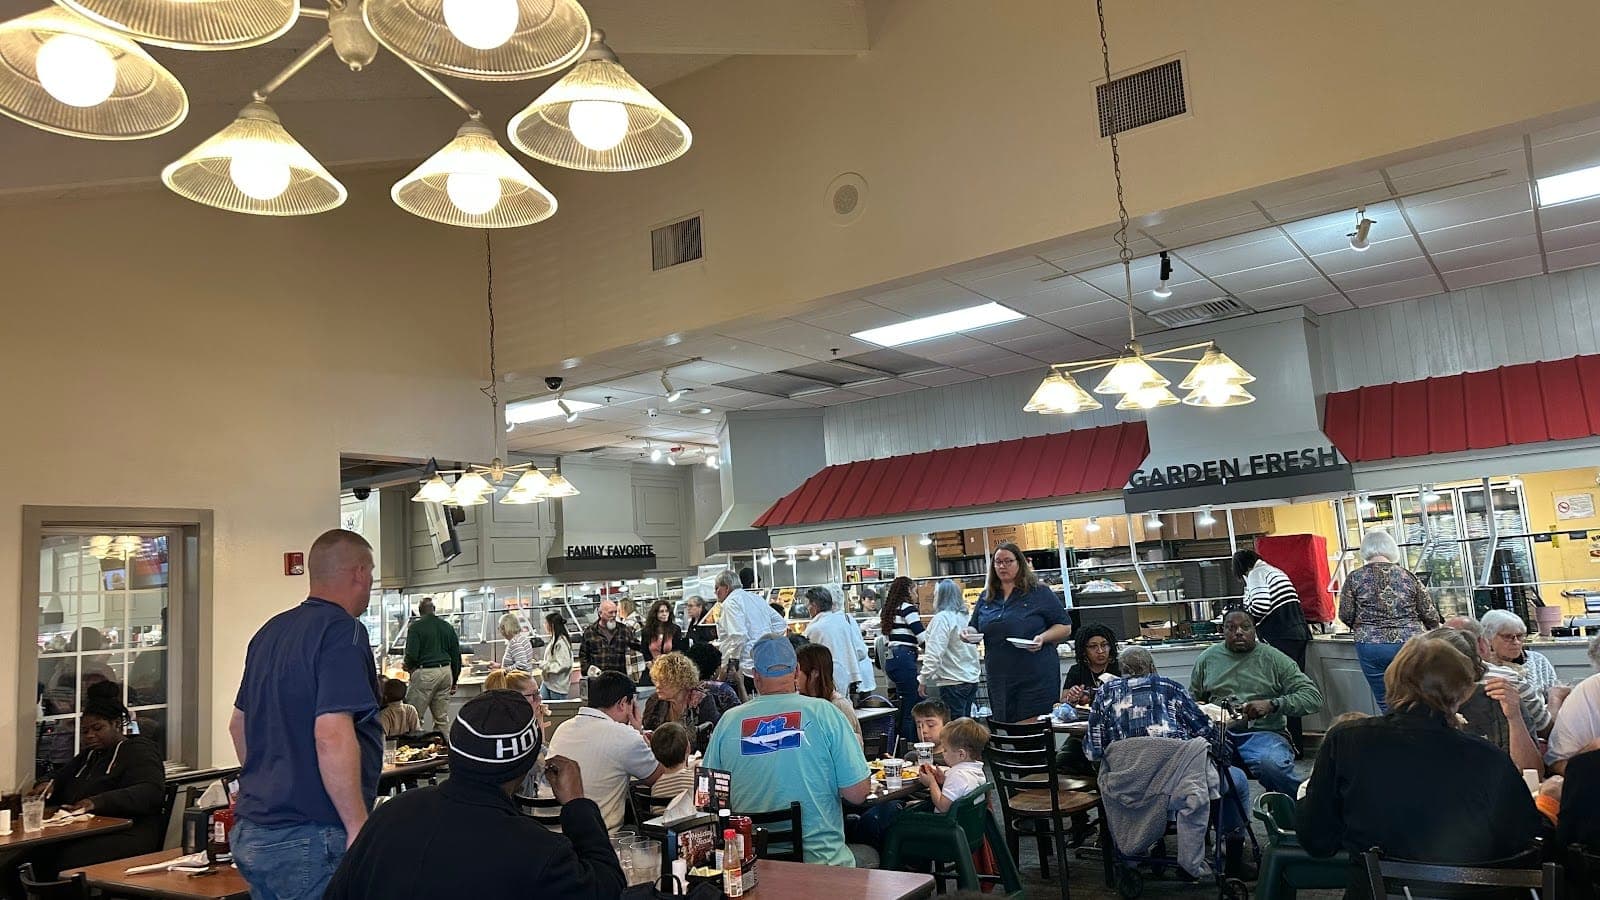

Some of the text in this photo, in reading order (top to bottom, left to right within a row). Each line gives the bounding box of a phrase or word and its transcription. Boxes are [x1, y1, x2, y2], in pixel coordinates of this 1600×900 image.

[1128, 446, 1339, 488] GARDEN FRESH
[567, 544, 654, 559] FAMILY FAVORITE
[496, 720, 539, 758] HO
